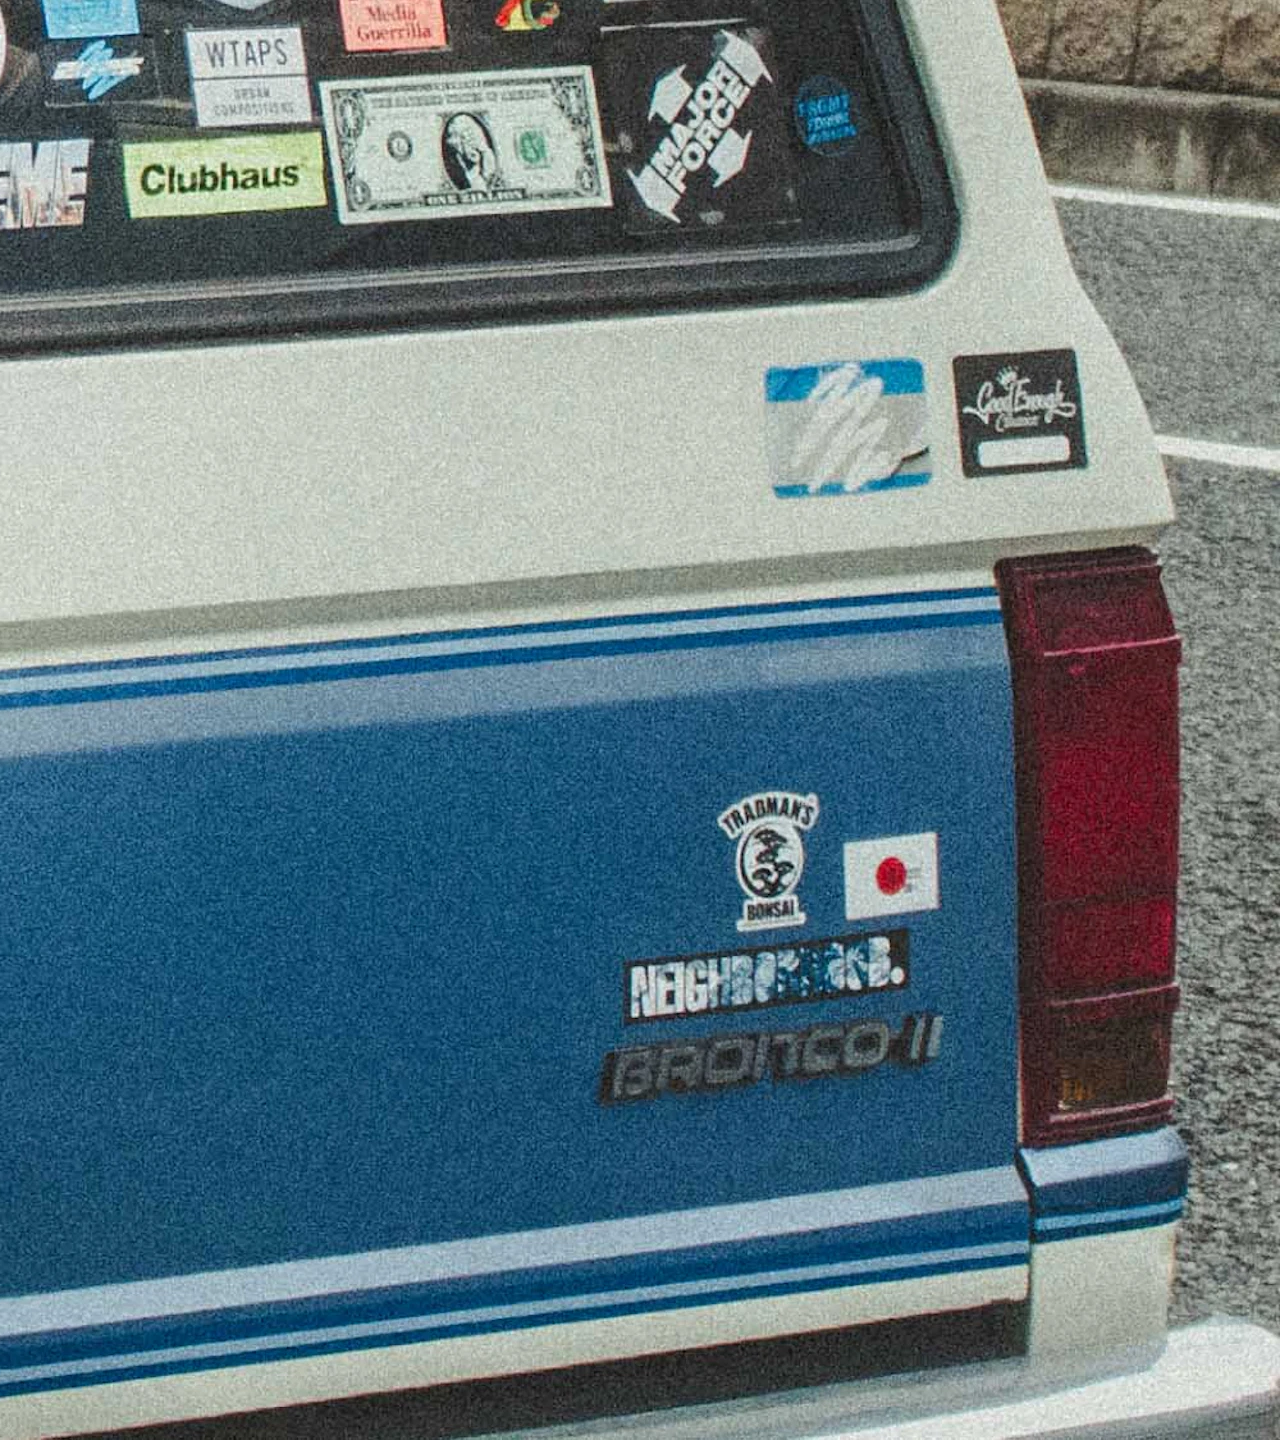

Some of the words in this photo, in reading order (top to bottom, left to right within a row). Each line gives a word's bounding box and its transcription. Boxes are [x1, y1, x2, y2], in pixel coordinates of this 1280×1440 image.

[366, 4, 417, 23] Media
[357, 23, 433, 43] Guerrilla
[205, 38, 289, 69] WTAPS
[140, 161, 300, 196] Clubhaus
[720, 796, 815, 836] TRADMAN'S
[745, 898, 796, 921] BONSAI
